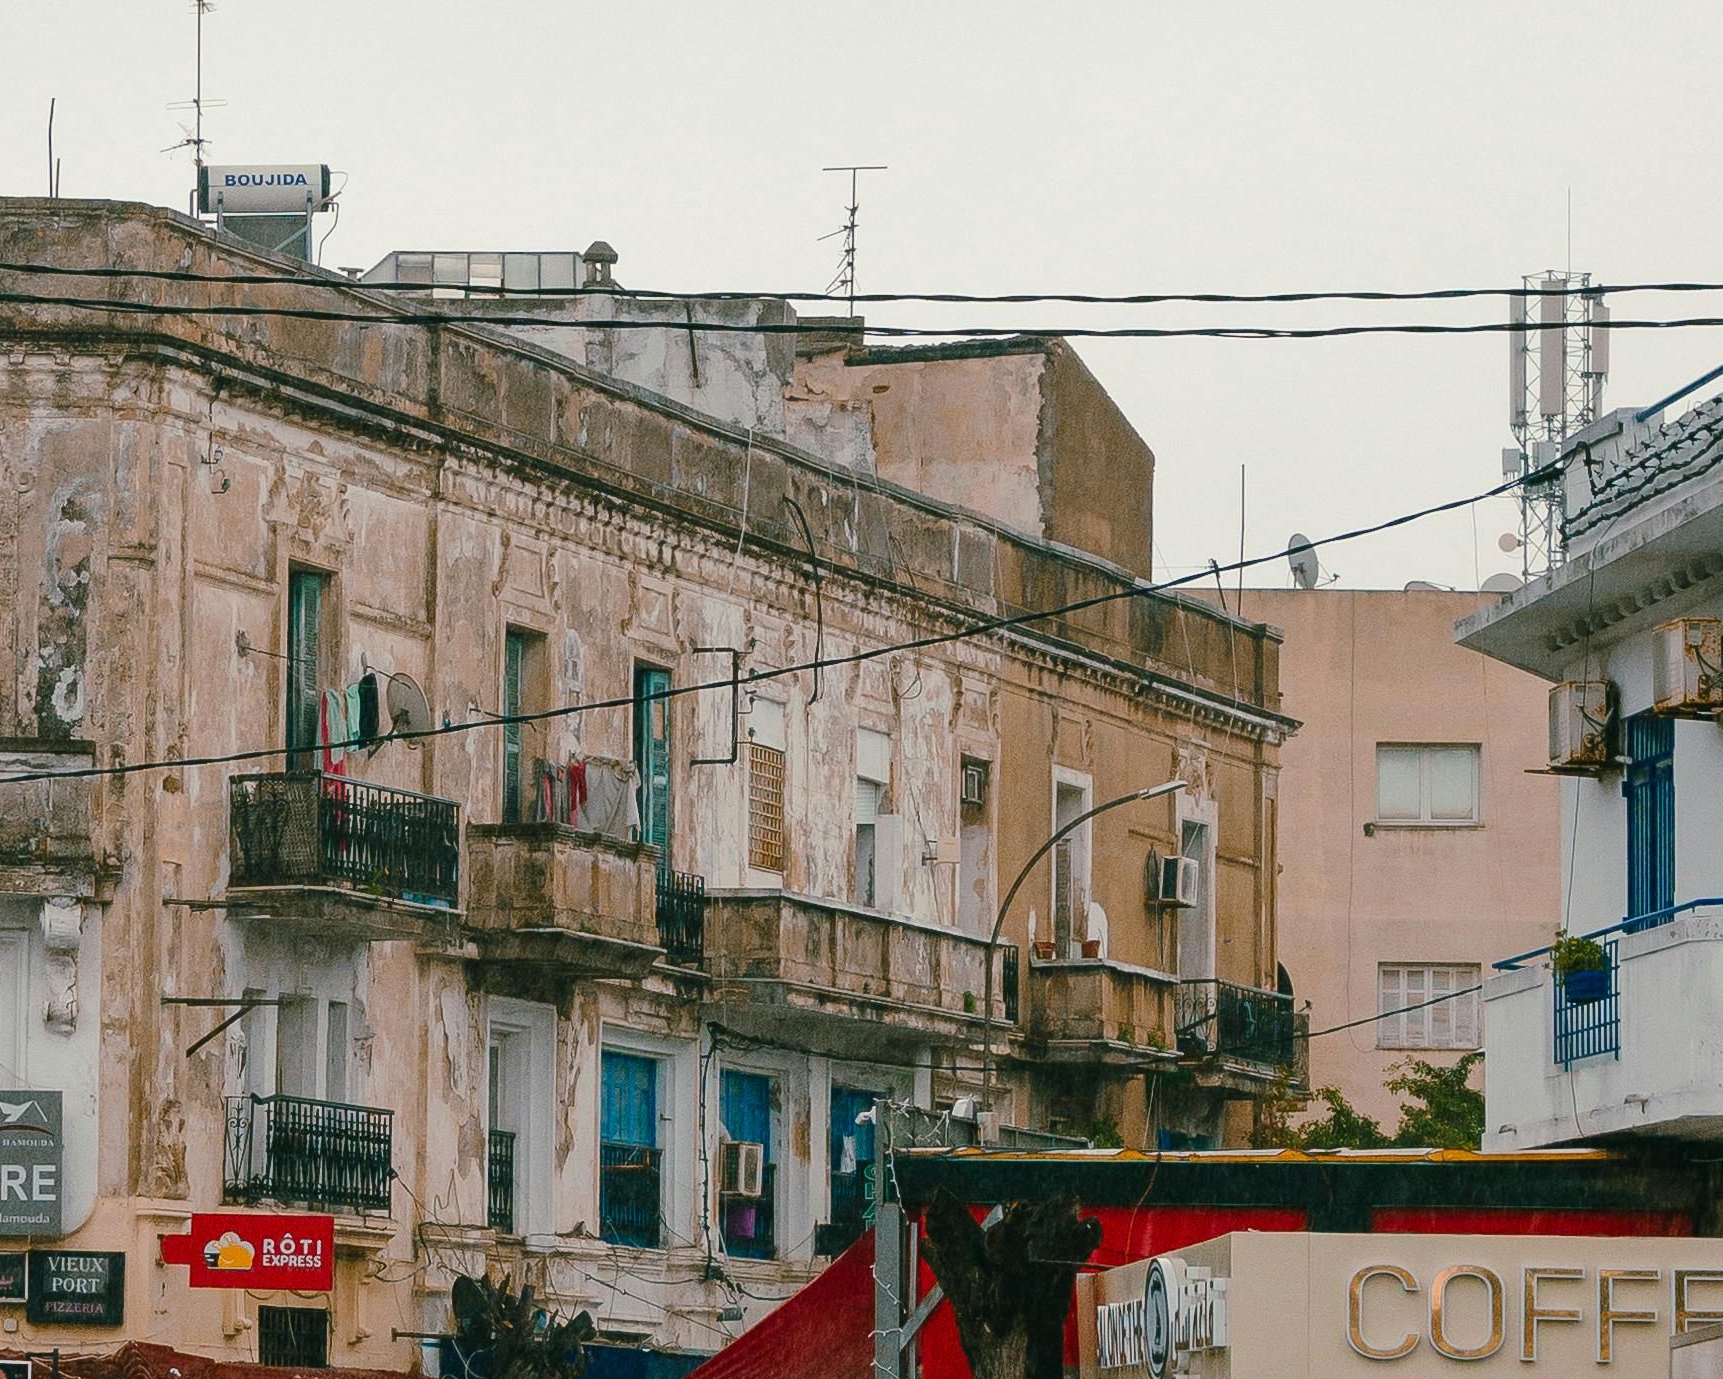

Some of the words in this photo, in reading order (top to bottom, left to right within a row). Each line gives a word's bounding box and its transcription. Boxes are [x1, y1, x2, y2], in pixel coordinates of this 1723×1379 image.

[224, 174, 308, 186] BOUJIDA
[3, 1138, 55, 1147] HAMOUDA
[262, 1232, 322, 1255] RÔTI
[47, 1256, 105, 1273] VIEUX
[262, 1254, 322, 1268] EXPRESS
[52, 1277, 101, 1294] PORT
[44, 1301, 105, 1314] PIZZERIA
